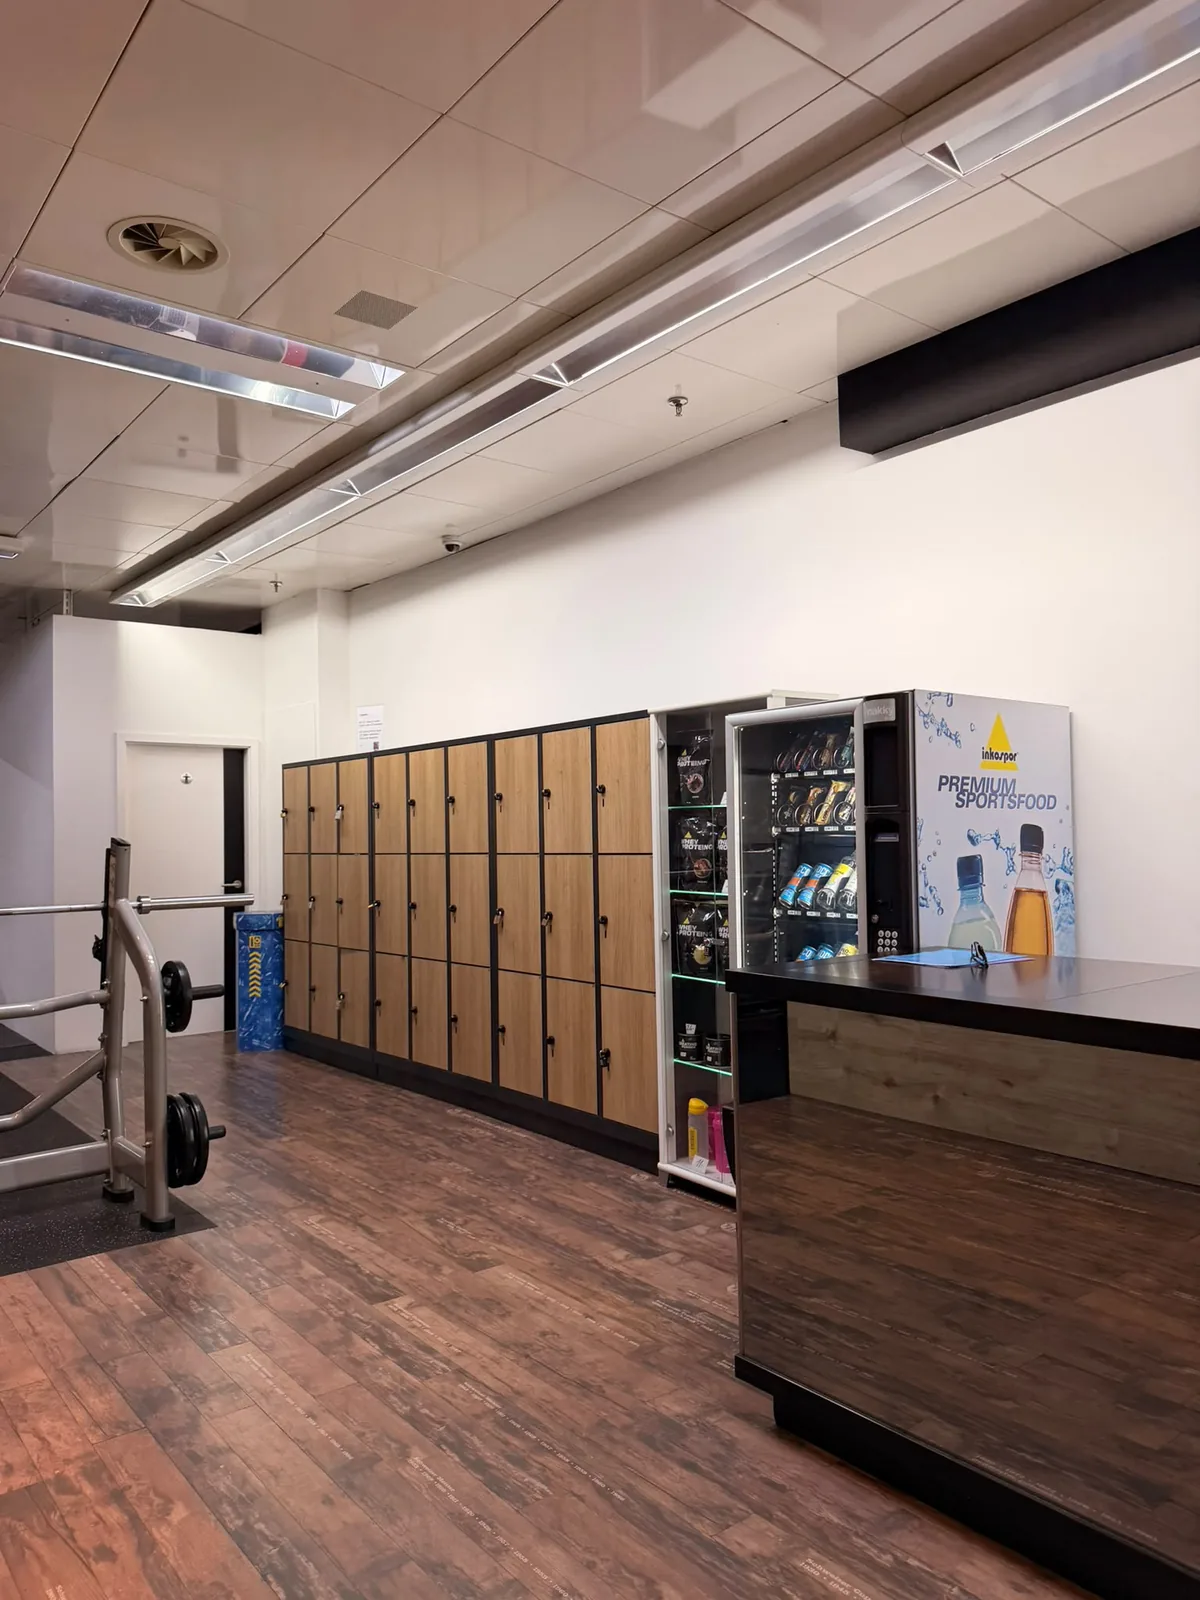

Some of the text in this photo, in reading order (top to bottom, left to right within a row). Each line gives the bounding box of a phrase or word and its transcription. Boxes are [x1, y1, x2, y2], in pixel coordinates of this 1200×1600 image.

[982, 747, 1017, 763] inkospor
[938, 775, 1017, 796] PREMIUM
[955, 792, 1057, 810] SPORTSFOOD
